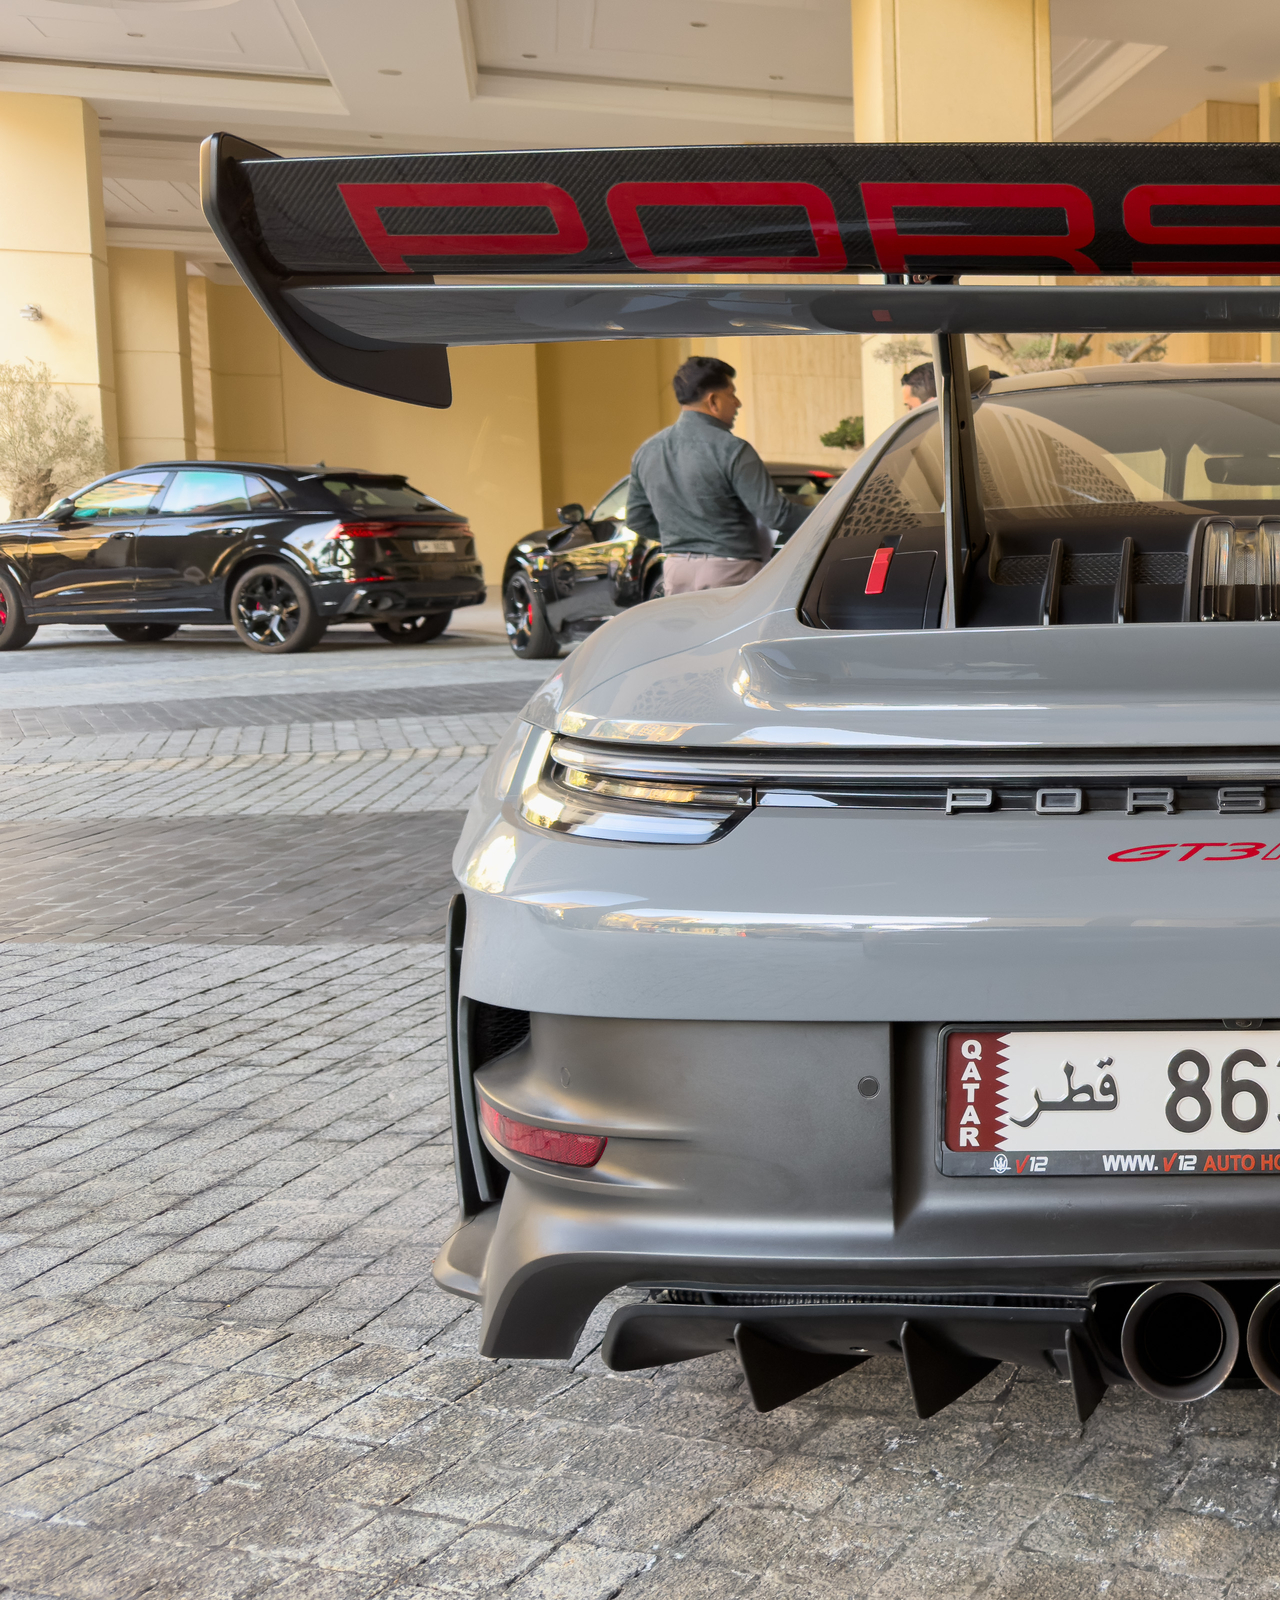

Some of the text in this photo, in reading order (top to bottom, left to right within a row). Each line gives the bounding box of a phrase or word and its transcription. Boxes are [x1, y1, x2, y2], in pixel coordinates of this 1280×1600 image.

[959, 1039, 983, 1147] QATAR
[1008, 1055, 1119, 1128] قطر
[1015, 1153, 1049, 1173] V12
[1102, 1154, 1159, 1173] WWW.
[1163, 1152, 1197, 1173] V12
[1203, 1154, 1255, 1173] AUTO
